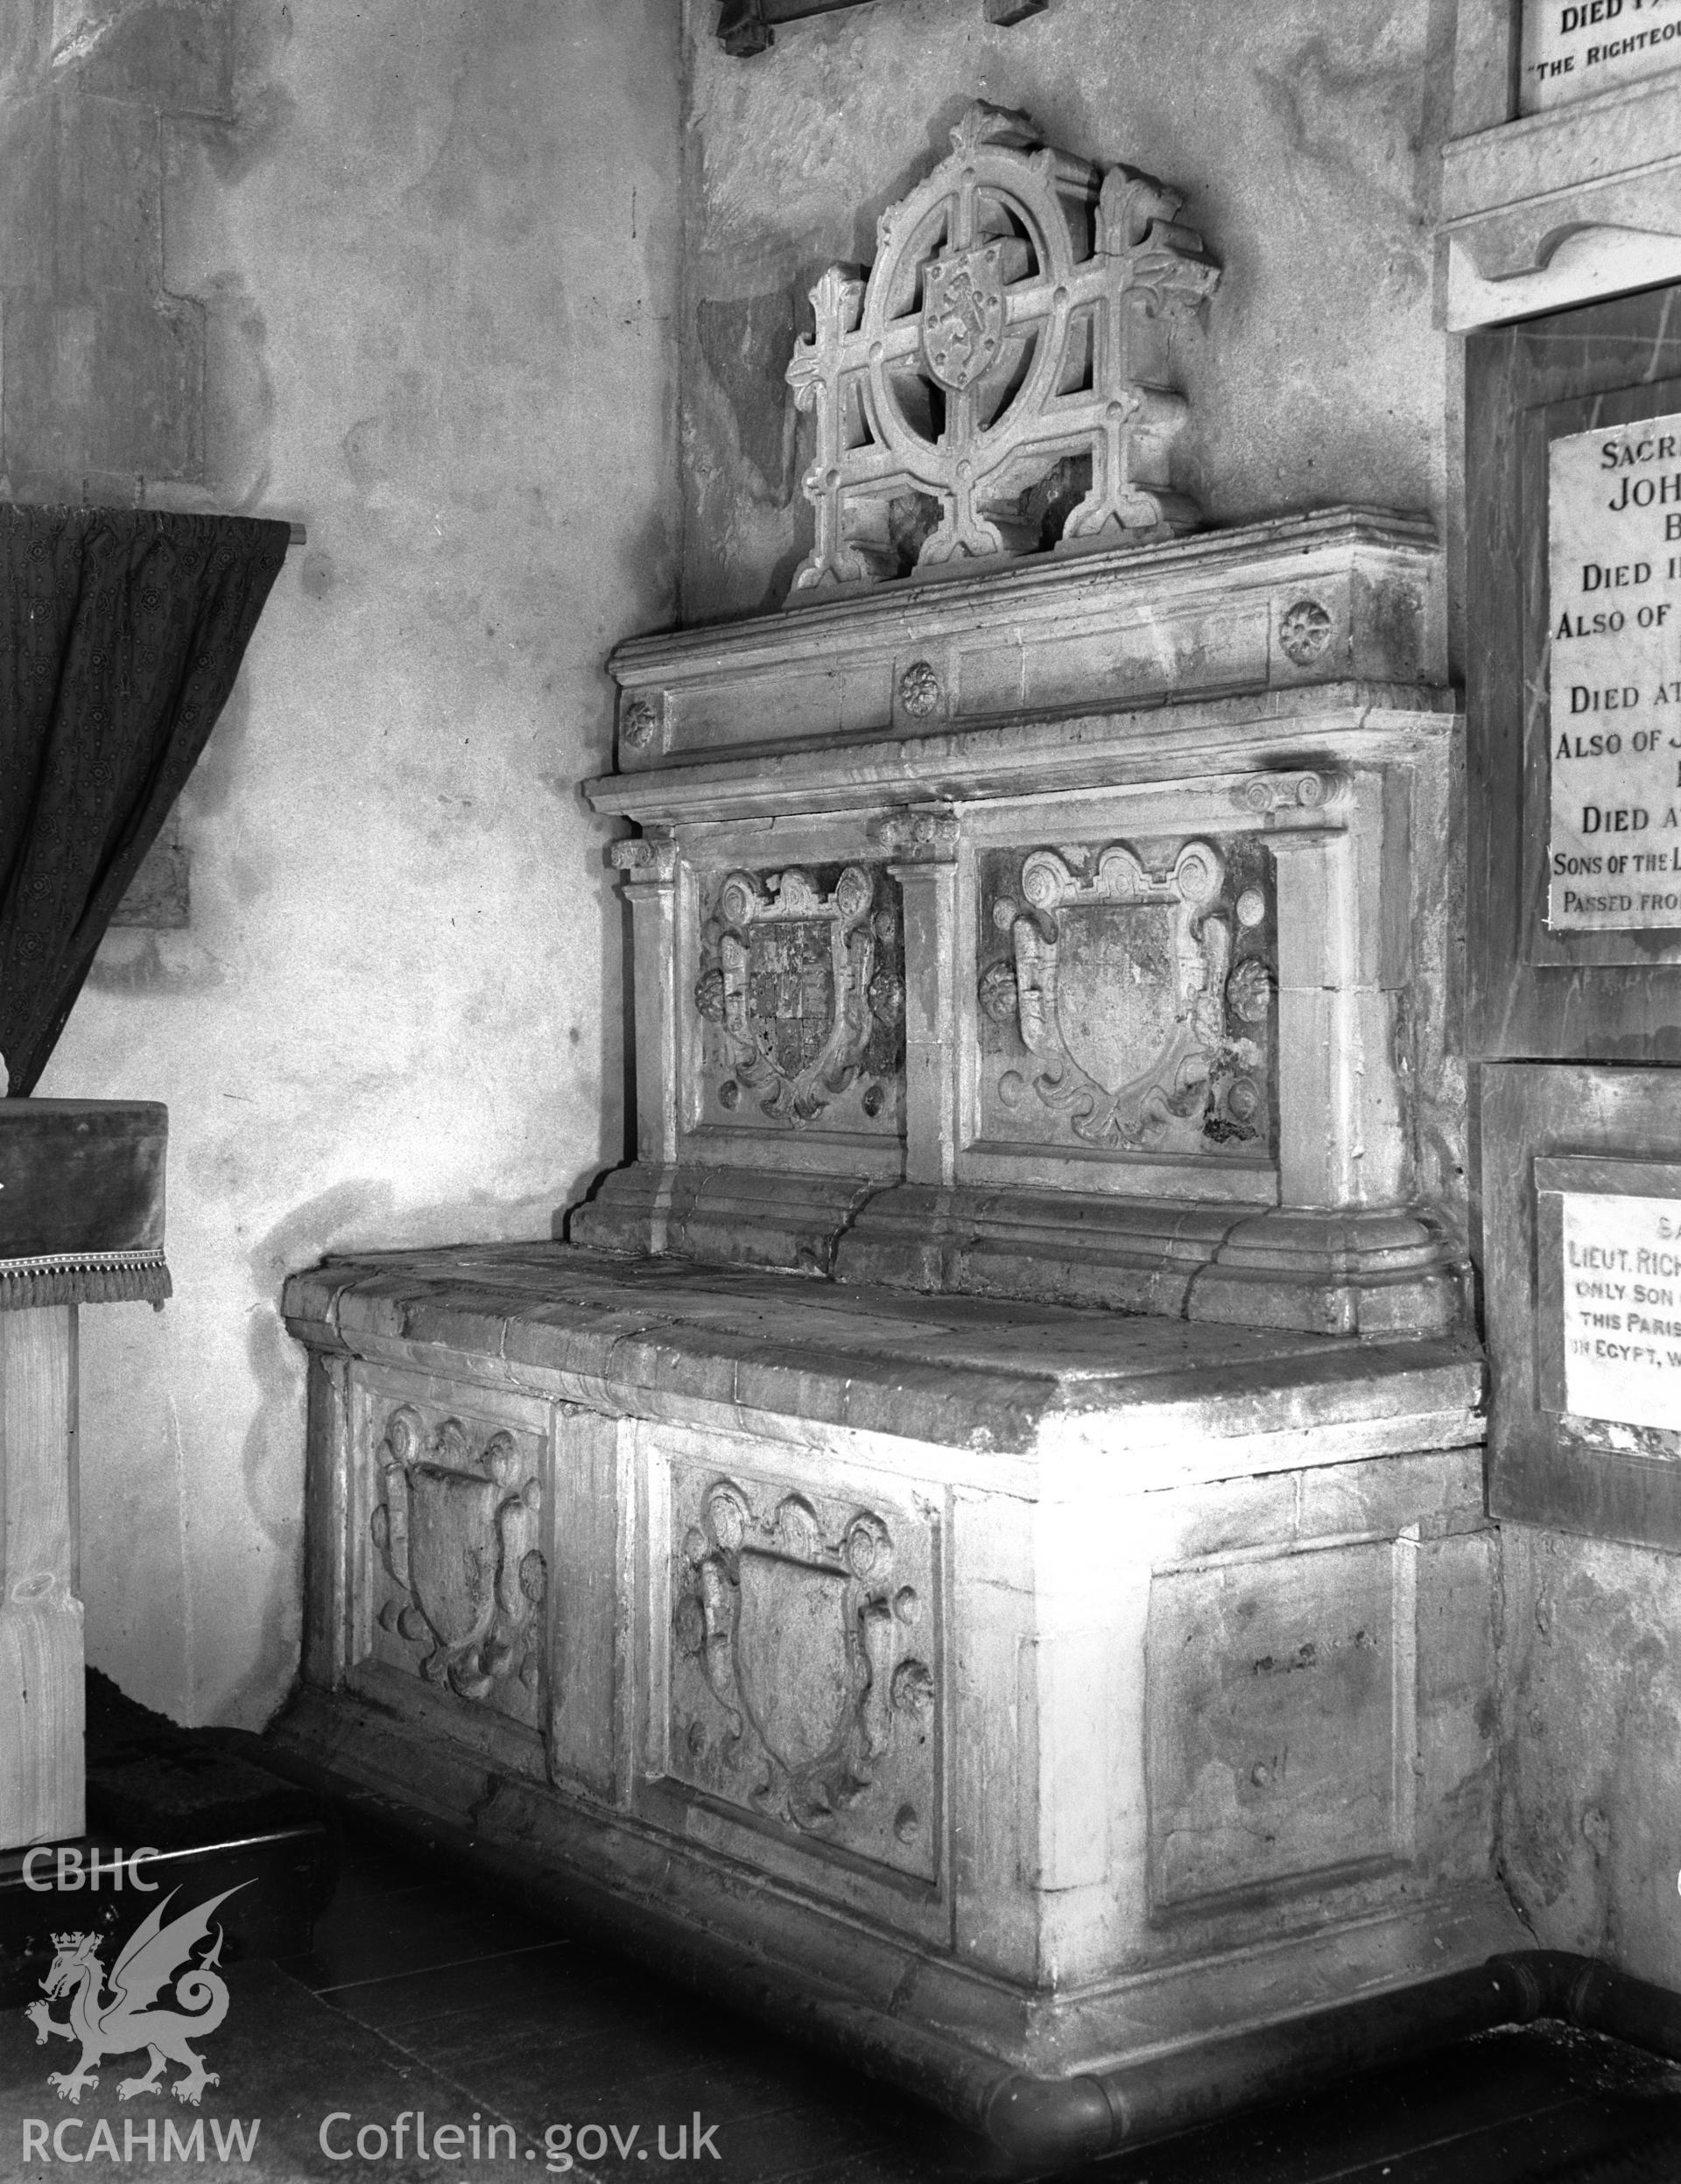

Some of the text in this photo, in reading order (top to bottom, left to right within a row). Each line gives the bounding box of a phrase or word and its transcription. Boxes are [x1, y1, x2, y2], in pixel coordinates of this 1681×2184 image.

[1560, 0, 1623, 34] DIED
[1601, 435, 1681, 469] SACR
[1582, 562, 1651, 593] DIED
[1556, 604, 1671, 640] ALSO OF
[1571, 685, 1639, 713] DIED
[1556, 732, 1621, 759] ALSO
[1632, 729, 1662, 752] OF
[1582, 806, 1681, 833] DIED A
[1553, 853, 1602, 875] SONS
[1607, 855, 1628, 874] OF
[1632, 853, 1668, 872] THE
[1564, 891, 1681, 913] PASSED FRO
[1568, 1240, 1633, 1273] LIEUT.
[1576, 1281, 1626, 1301] ONLY
[1633, 1284, 1672, 1306] SON
[1580, 1311, 1621, 1331] THIS
